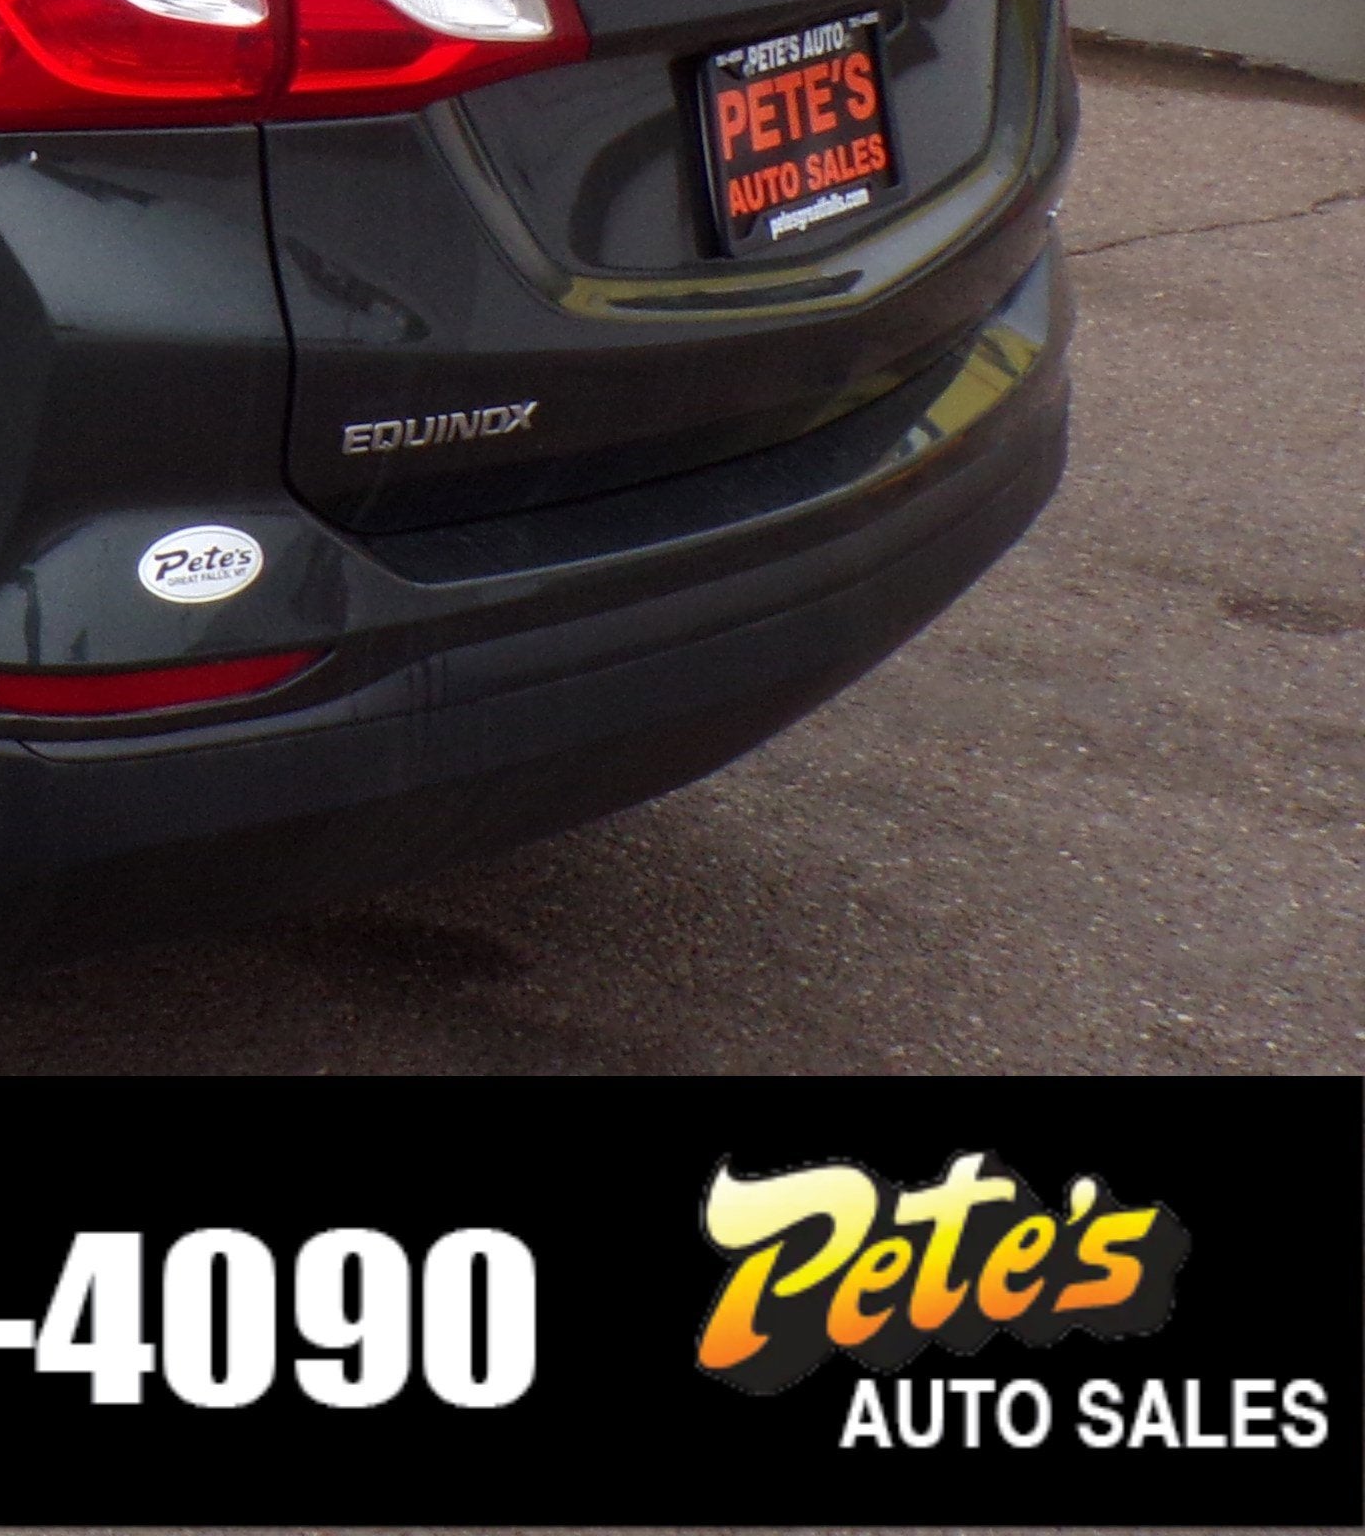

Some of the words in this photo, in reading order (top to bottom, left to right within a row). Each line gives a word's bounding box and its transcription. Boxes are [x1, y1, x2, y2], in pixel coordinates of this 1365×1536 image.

[744, 33, 801, 76] PETE'S
[802, 20, 845, 59] AUTO
[715, 50, 878, 161] PETE'S
[728, 161, 801, 218] AUTO
[805, 132, 888, 192] SALES
[341, 399, 538, 455] EQUINOX
[154, 546, 253, 582] Pete's
